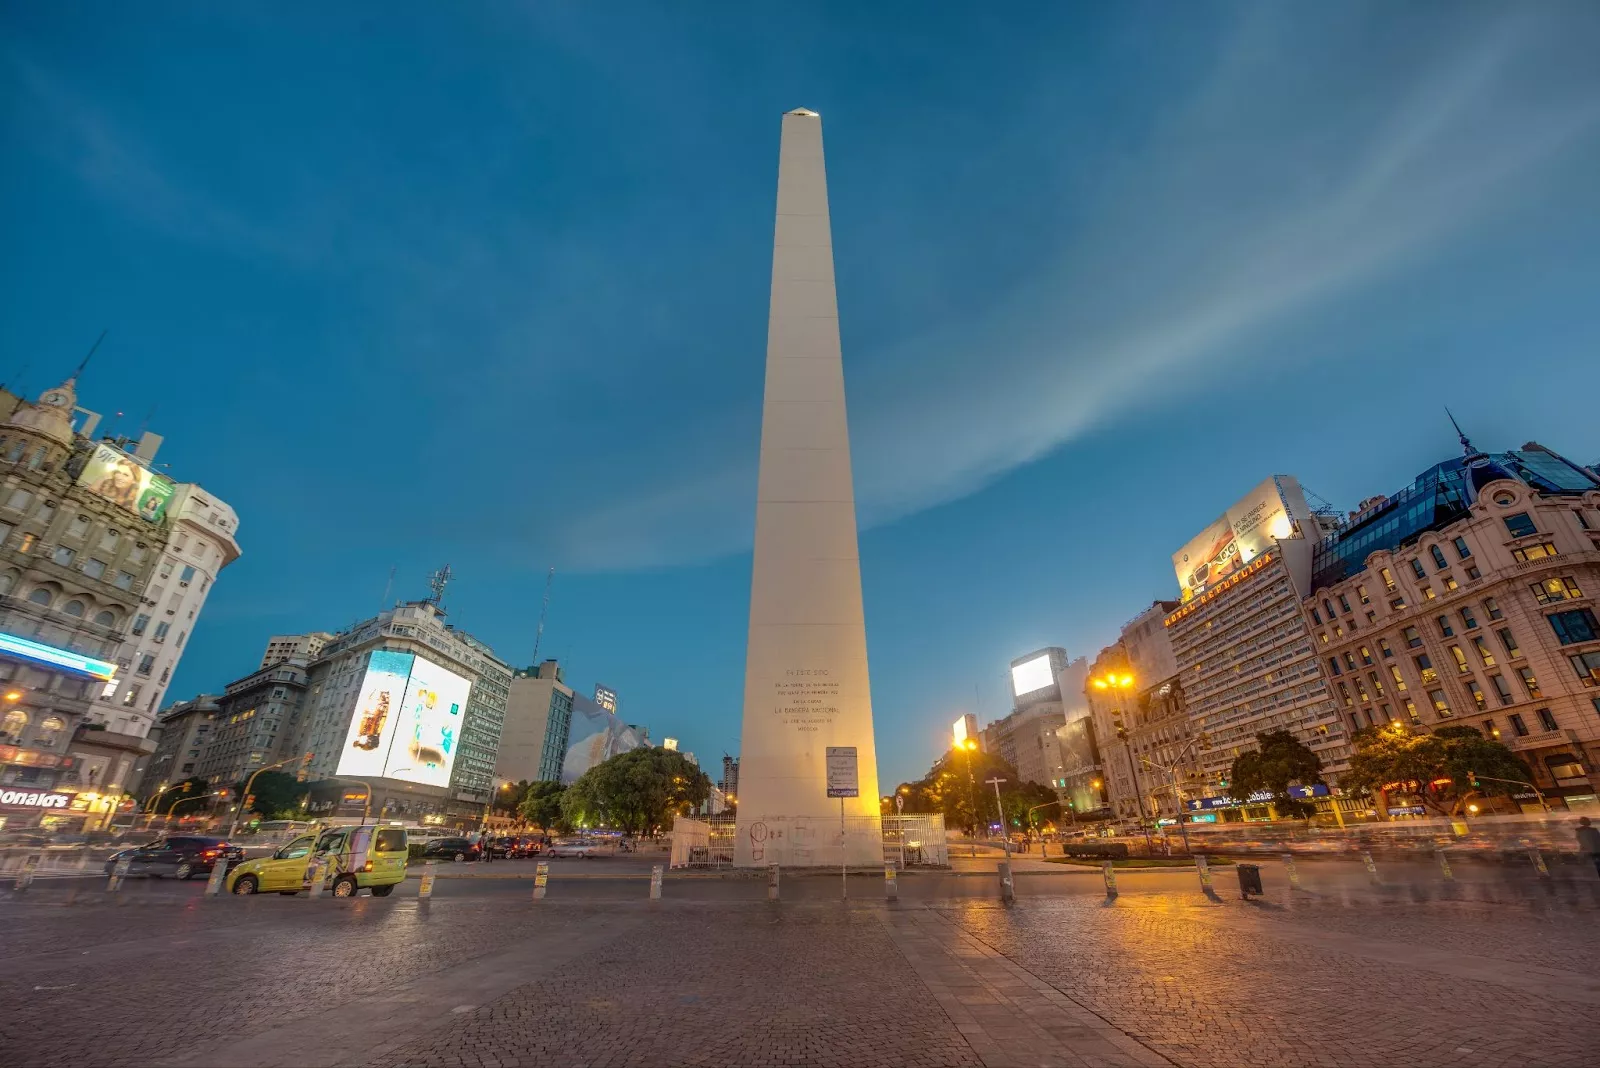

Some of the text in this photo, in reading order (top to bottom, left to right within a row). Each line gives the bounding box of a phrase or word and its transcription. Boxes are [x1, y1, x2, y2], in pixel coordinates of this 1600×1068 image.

[1234, 501, 1267, 529] NO SE PARECE
[1164, 553, 1273, 627] HOTEL REPUBLICA
